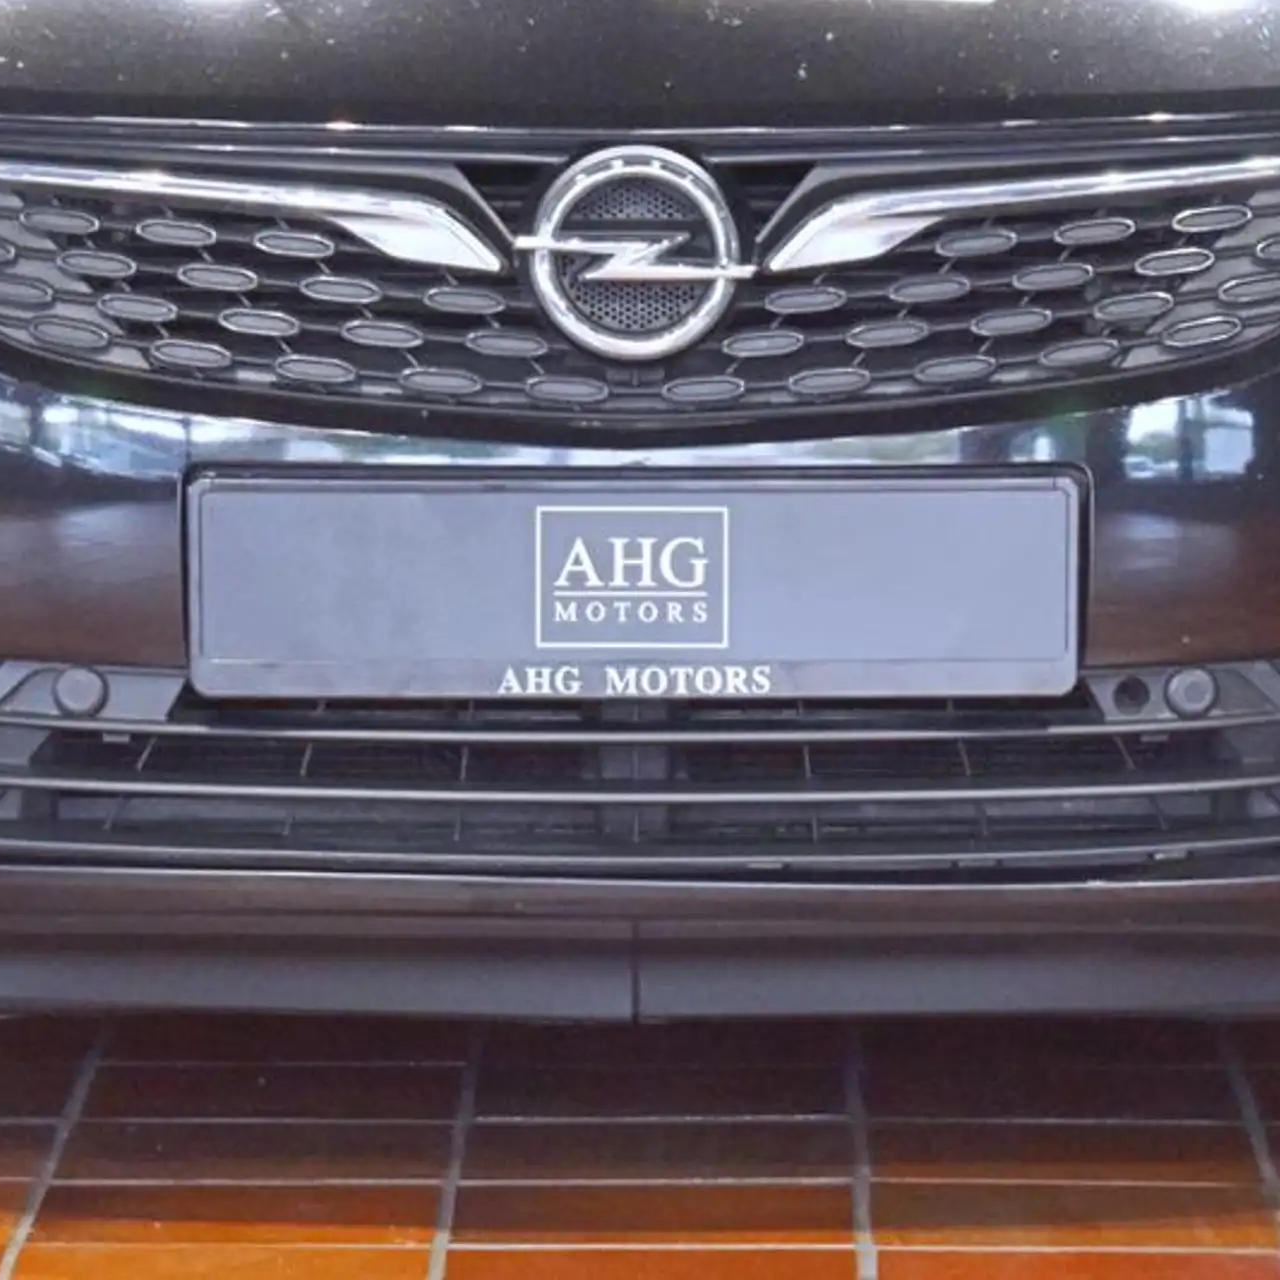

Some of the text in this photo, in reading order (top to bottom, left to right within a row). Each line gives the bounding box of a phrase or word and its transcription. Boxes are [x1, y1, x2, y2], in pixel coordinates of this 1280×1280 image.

[553, 536, 708, 588] AHG
[554, 600, 708, 623] MOTORS
[496, 665, 772, 695] AHG MOTORS
